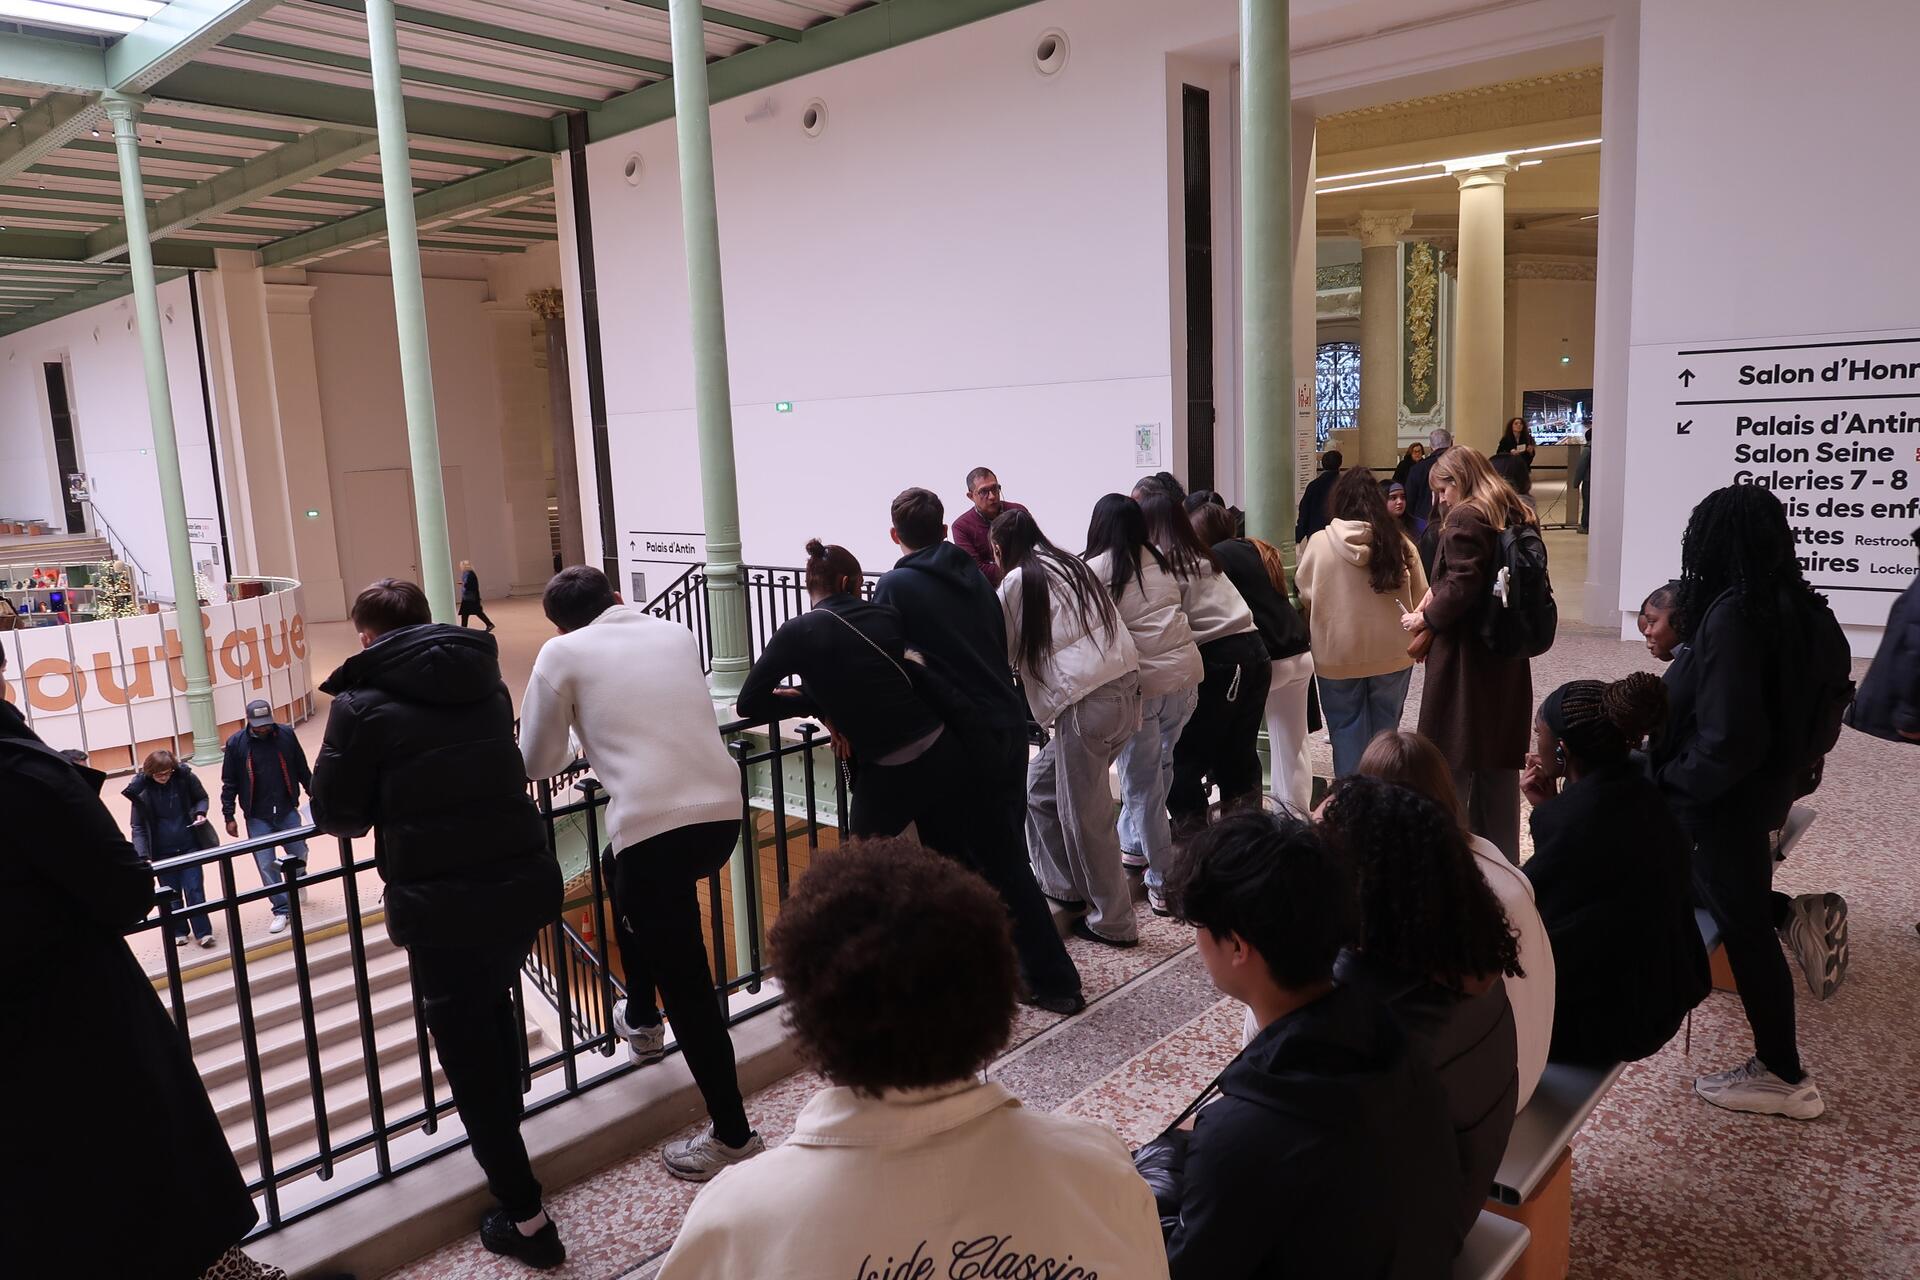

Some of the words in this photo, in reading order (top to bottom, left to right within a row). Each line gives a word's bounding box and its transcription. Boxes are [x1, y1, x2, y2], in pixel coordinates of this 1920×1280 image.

[1738, 364, 1814, 385] Salon
[1736, 414, 1814, 436] Palais
[1821, 411, 1920, 435] d'Antin
[1735, 444, 1809, 463] Salon
[1816, 441, 1894, 462] Seine
[1734, 469, 1843, 490] Galeries
[1851, 470, 1867, 490] 7
[1891, 470, 1907, 490] 8
[1816, 498, 1864, 517] des
[1871, 498, 1920, 518] enf
[1791, 527, 1844, 544] ttes
[646, 542, 667, 553] Palais
[1797, 551, 1859, 572] aires
[6, 613, 305, 711] outique
